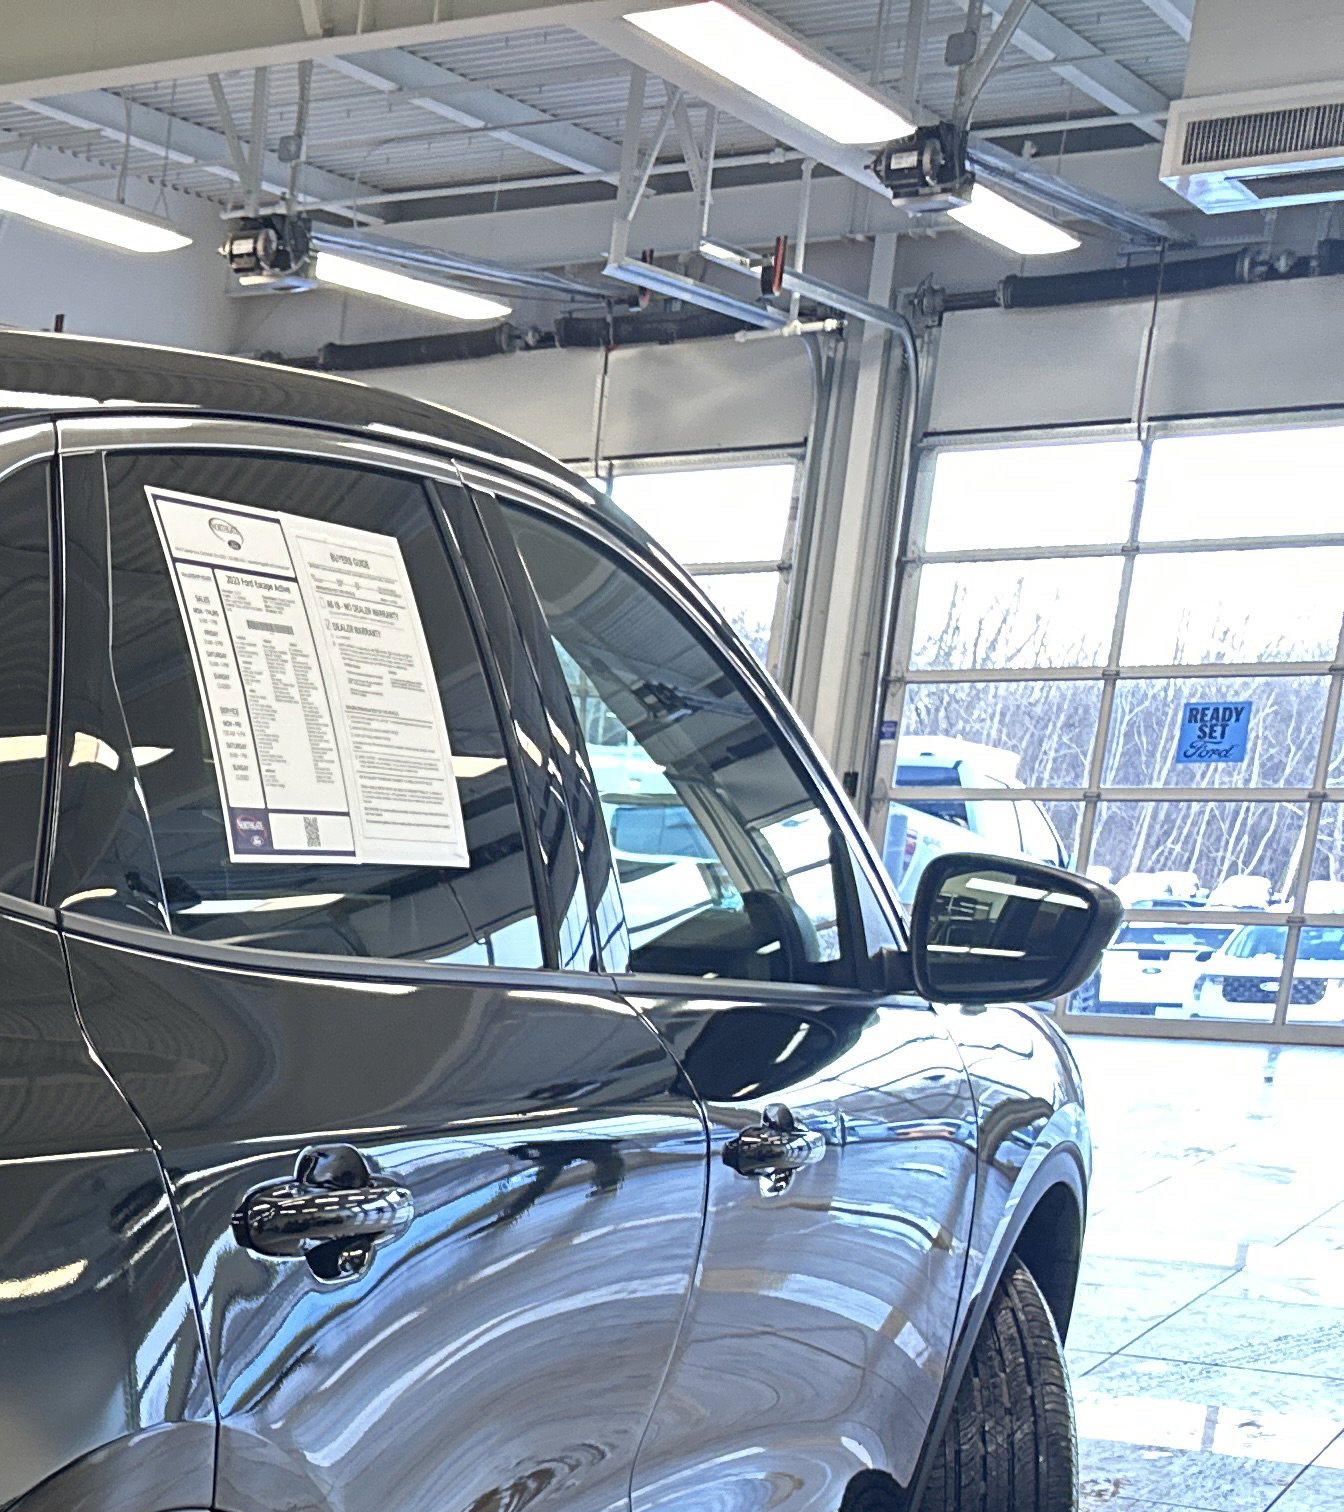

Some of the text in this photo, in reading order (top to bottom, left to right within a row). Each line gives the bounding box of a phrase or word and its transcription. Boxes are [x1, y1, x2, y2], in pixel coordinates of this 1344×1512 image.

[1188, 706, 1245, 723] READY
[1197, 722, 1229, 740] SET
[1183, 740, 1238, 758] Ford
